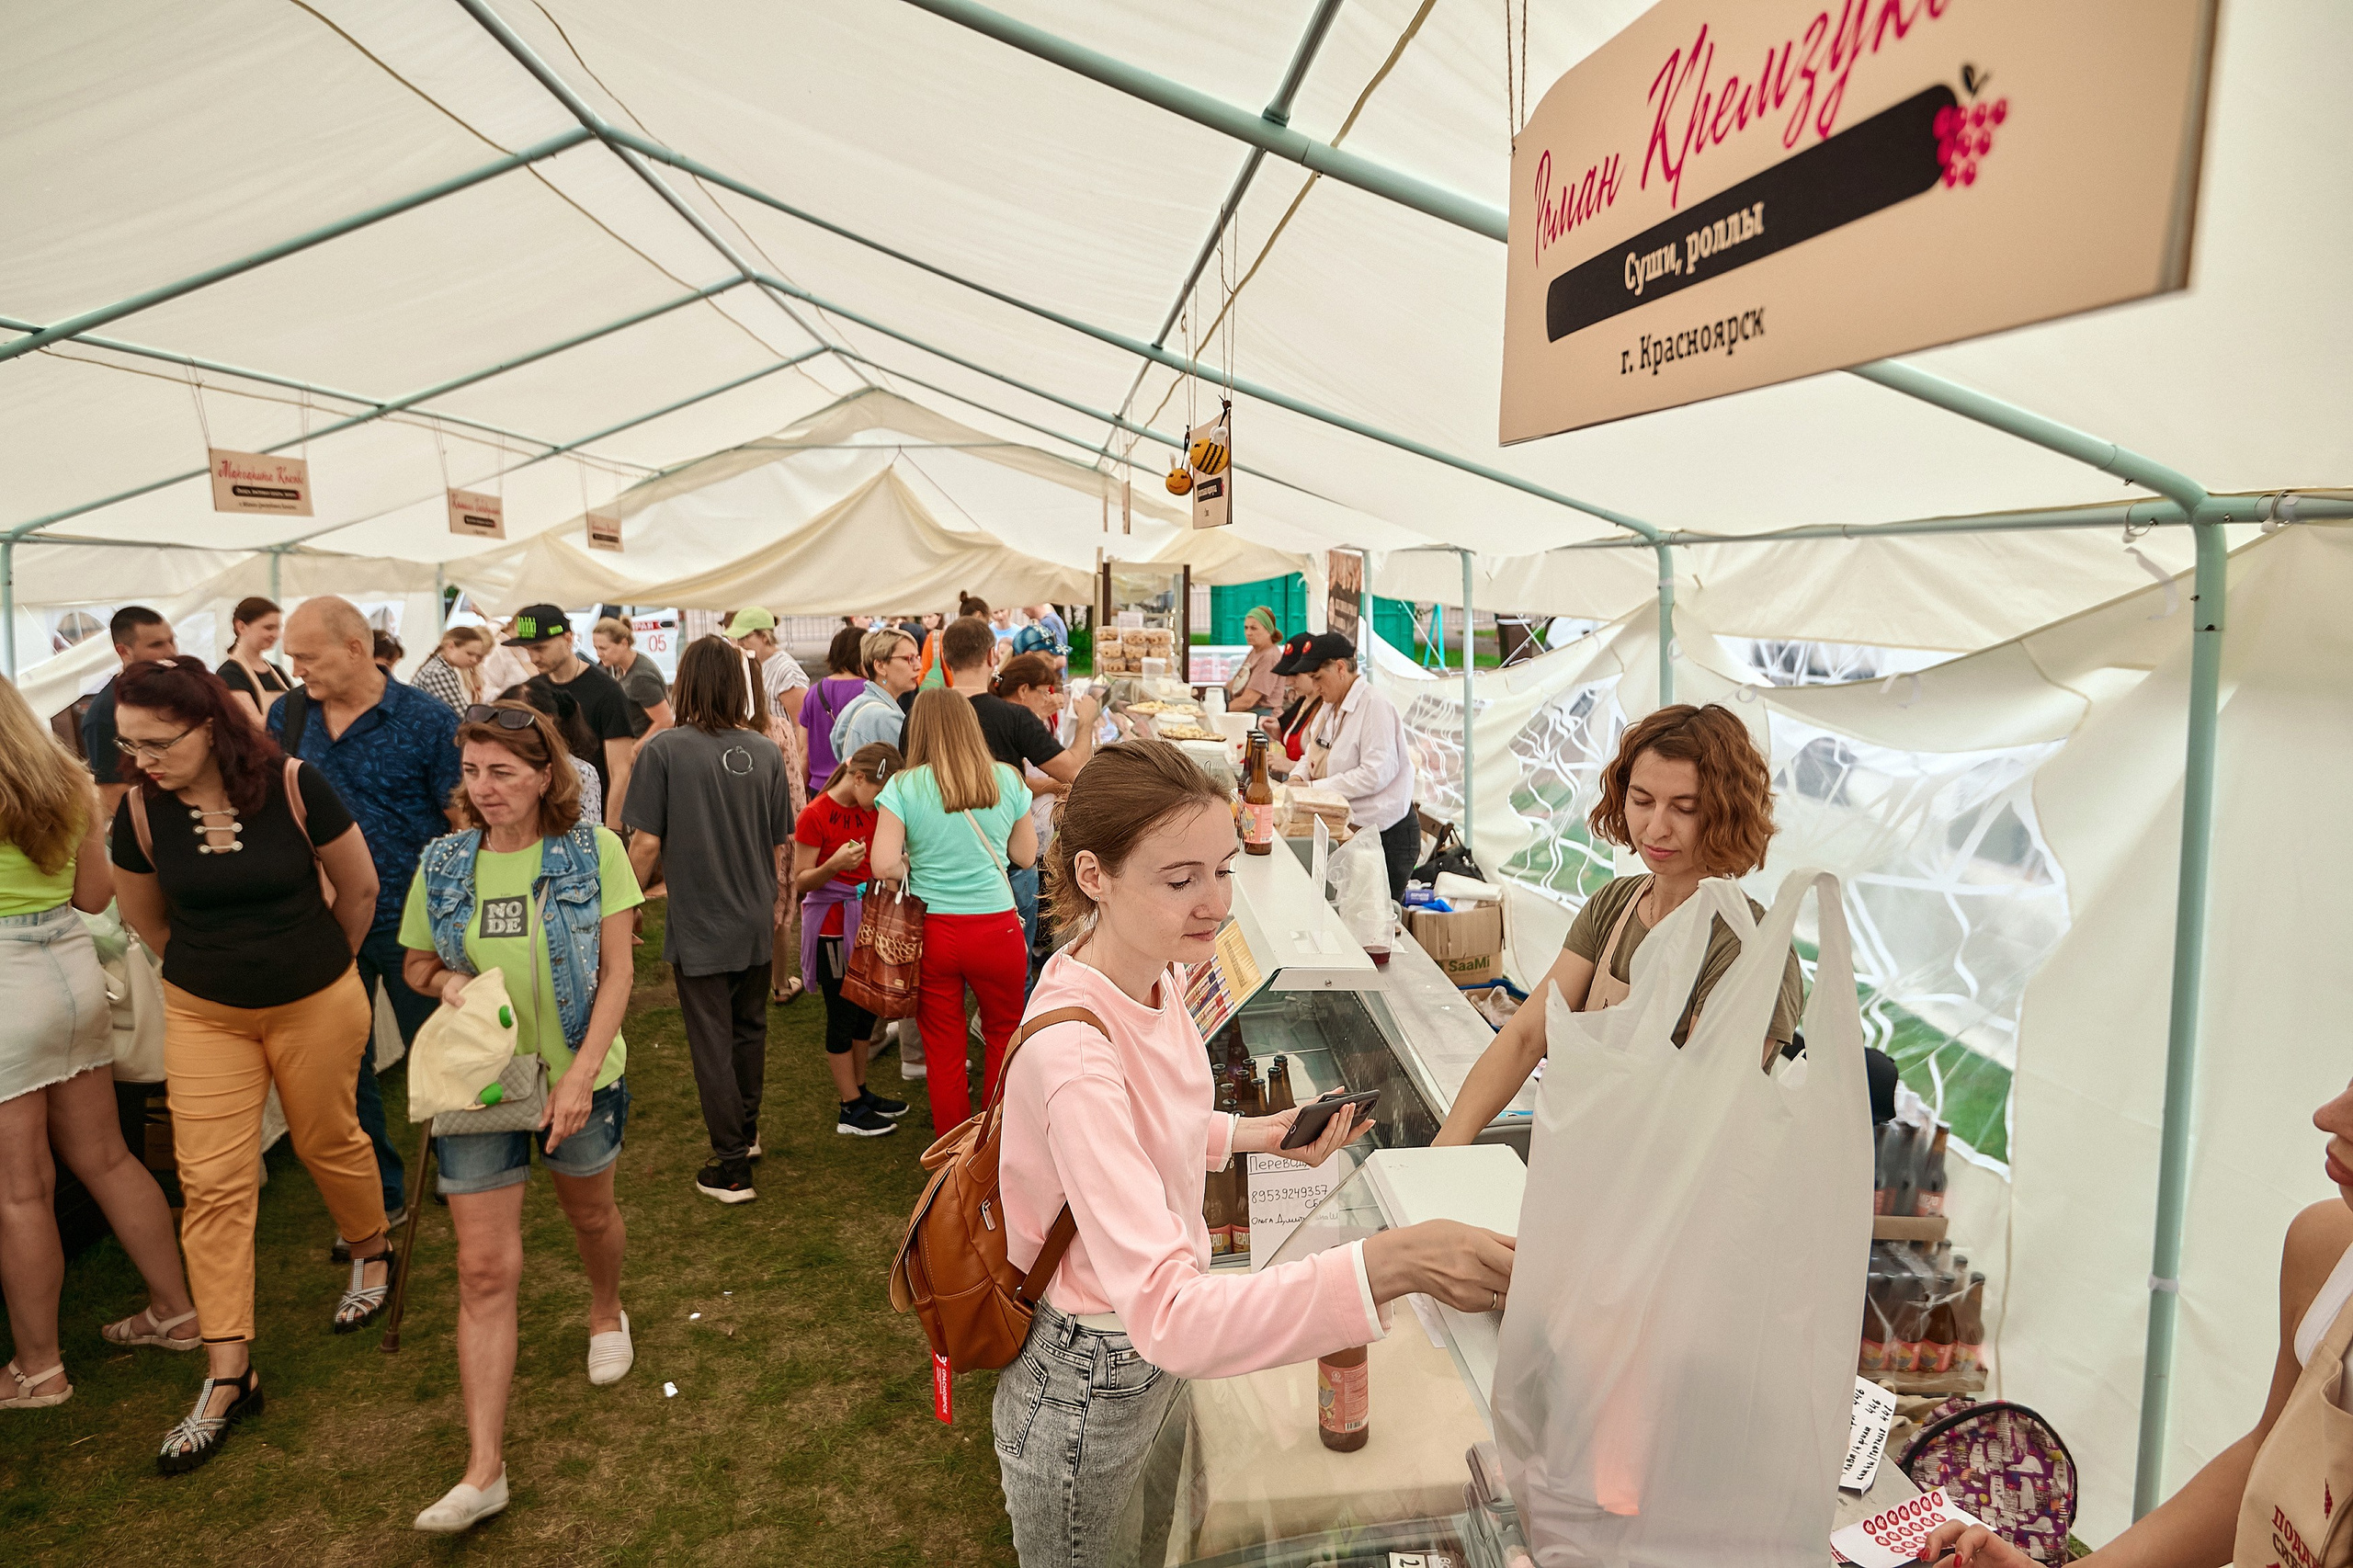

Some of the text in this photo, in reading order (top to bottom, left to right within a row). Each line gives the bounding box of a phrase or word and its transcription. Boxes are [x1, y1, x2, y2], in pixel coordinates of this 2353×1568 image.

[1534, 0, 1950, 269] Роман Кремзук
[1624, 201, 1765, 296] Суши, роллы
[1620, 306, 1765, 376] г. Красноярск
[648, 634, 666, 653] 05
[487, 901, 523, 918] NO
[487, 916, 521, 933] DE
[1449, 955, 1490, 971] SaaMi
[1251, 1185, 1328, 1204] 89539249357
